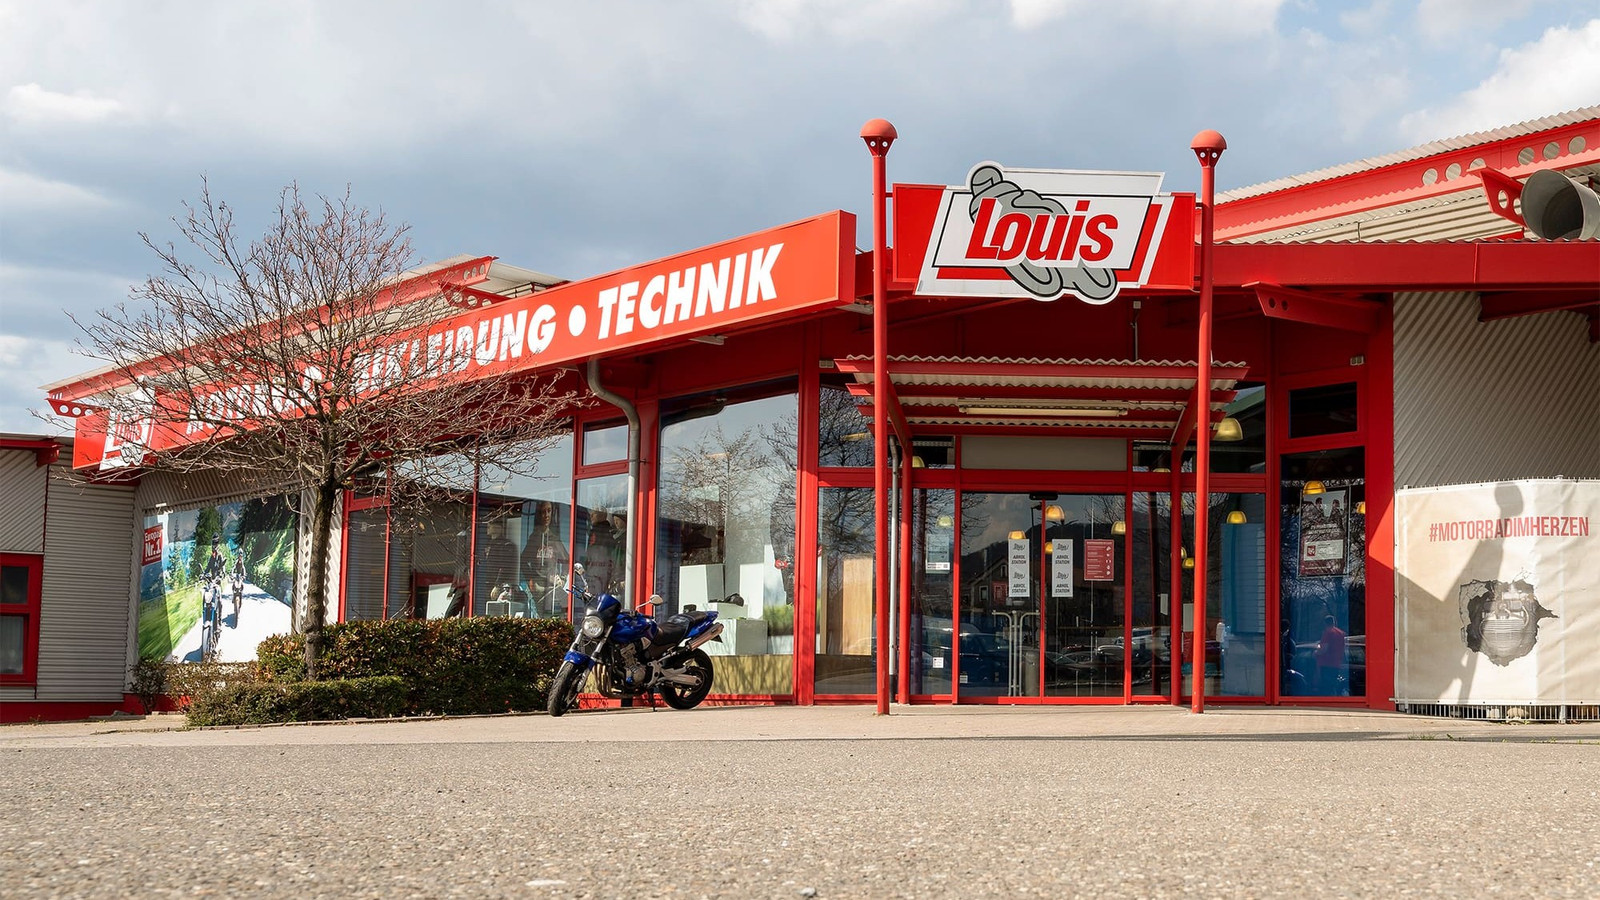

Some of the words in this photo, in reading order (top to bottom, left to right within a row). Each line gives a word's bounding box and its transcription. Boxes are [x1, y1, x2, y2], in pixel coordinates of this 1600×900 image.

[965, 197, 1118, 262] Louis
[598, 242, 785, 340] TECHNIK
[1429, 516, 1589, 542] #MOTORRADIMHERZEN
